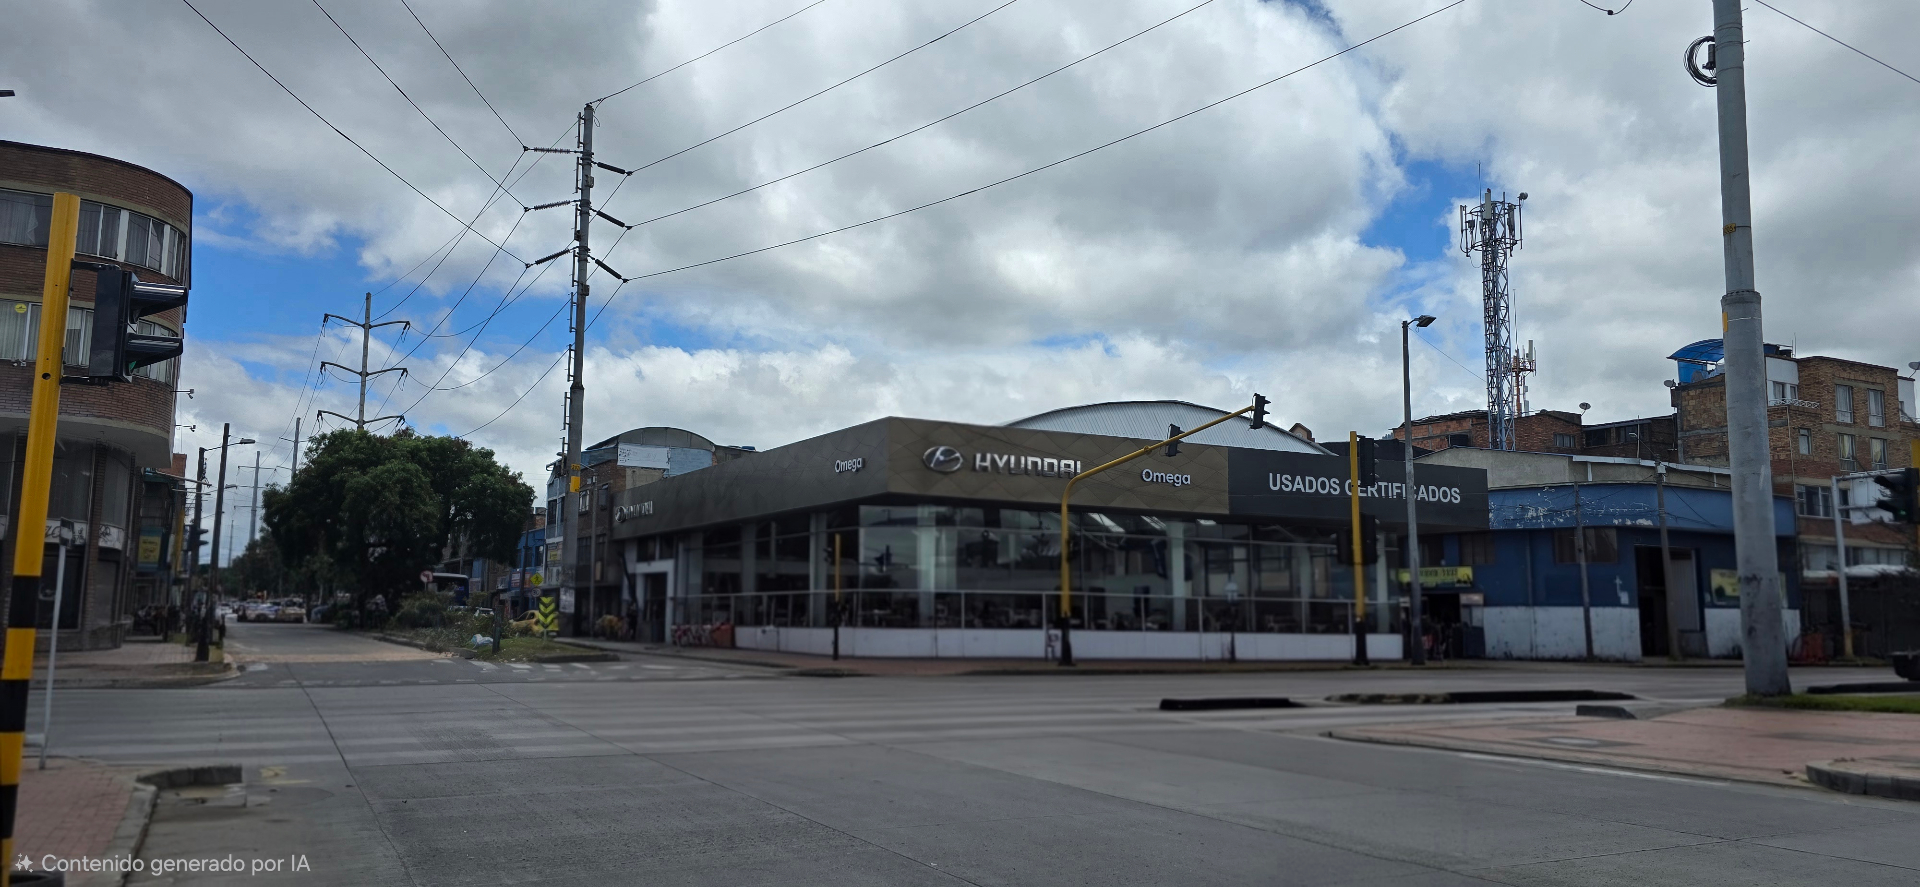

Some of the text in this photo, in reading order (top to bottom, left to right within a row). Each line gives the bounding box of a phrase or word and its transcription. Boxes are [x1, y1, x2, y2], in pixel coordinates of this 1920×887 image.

[834, 457, 864, 473] Omega
[974, 452, 1081, 478] HYUNDAI
[1141, 468, 1191, 487] Omega
[1268, 472, 1461, 504] USADOS CERTIFIADOS
